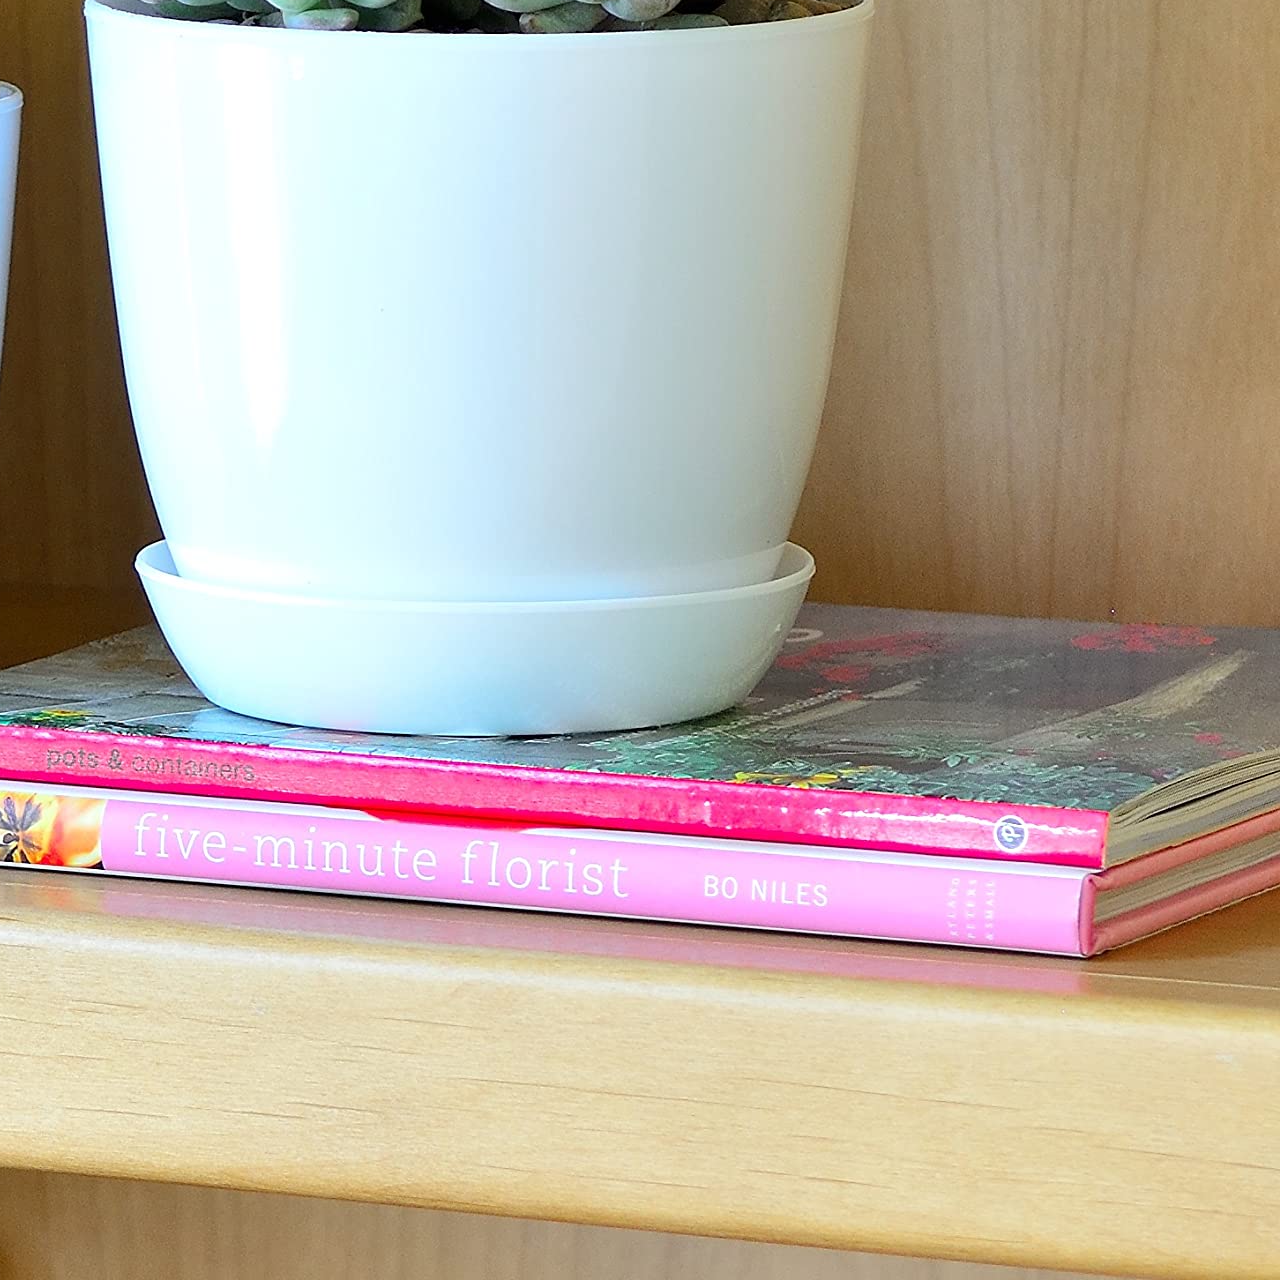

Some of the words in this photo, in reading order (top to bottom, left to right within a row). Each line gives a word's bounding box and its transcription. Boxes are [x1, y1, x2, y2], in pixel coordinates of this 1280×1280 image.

[46, 748, 99, 769] pots
[107, 748, 123, 770] &
[131, 754, 255, 781] containers
[134, 812, 438, 881] five-minute
[461, 839, 630, 898] florist
[704, 874, 738, 900] BO
[750, 878, 828, 907] NILES
